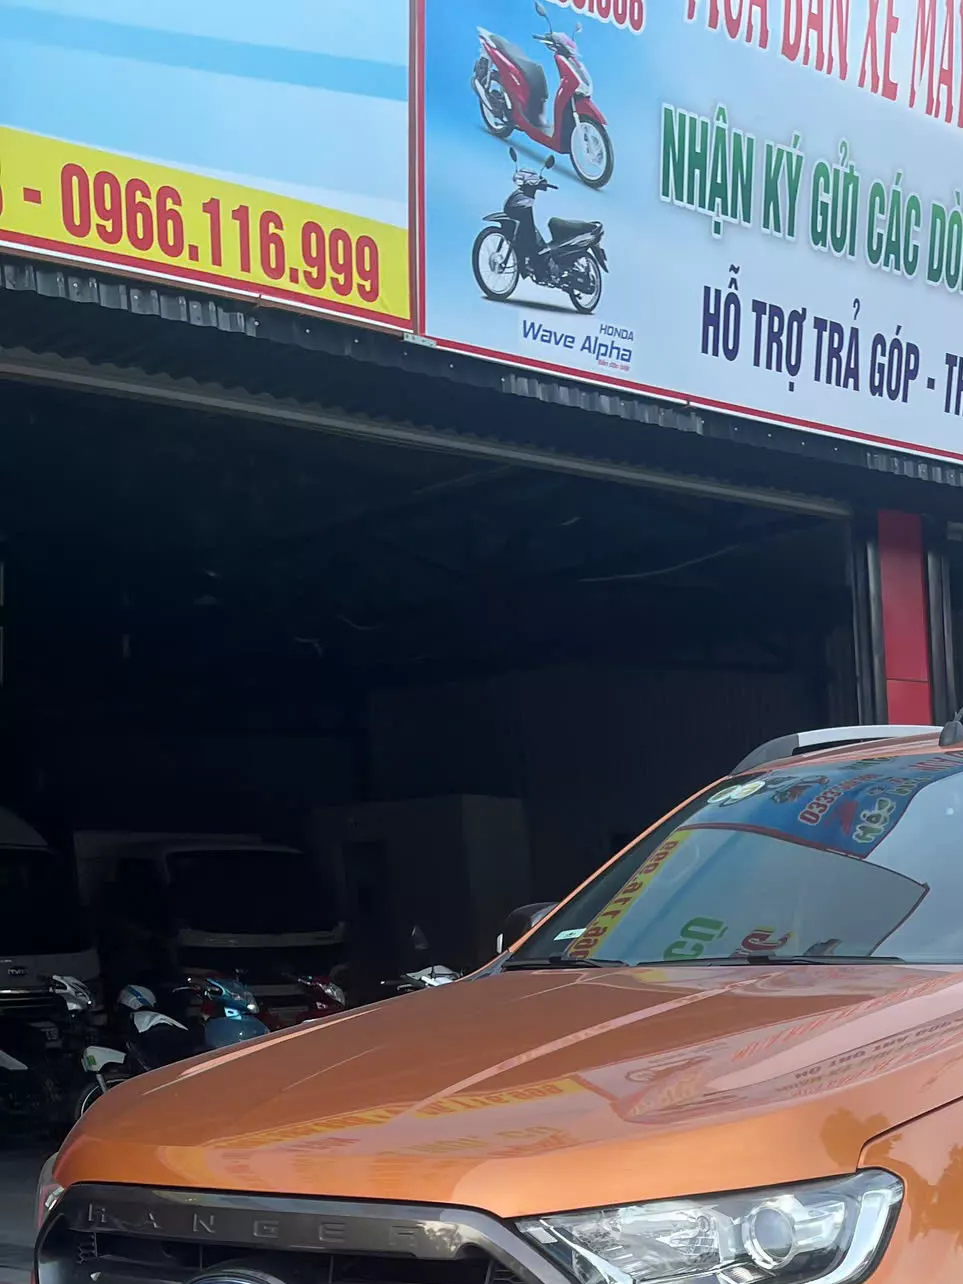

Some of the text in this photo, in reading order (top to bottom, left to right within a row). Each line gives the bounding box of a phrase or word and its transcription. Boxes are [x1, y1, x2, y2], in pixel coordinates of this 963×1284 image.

[60, 162, 379, 302] 0966.116.999
[661, 106, 756, 235] NHẬN
[763, 133, 804, 238] KÝ
[810, 139, 860, 257] GỬI
[867, 171, 921, 275] CÁC
[523, 320, 632, 362] Wave Alpha
[600, 324, 634, 341] HONDA
[701, 264, 741, 361] HỖ
[752, 299, 807, 392] TRỢ
[813, 298, 861, 392] TRẢ
[870, 325, 919, 403] GÓP
[87, 1201, 421, 1249] RANGER
